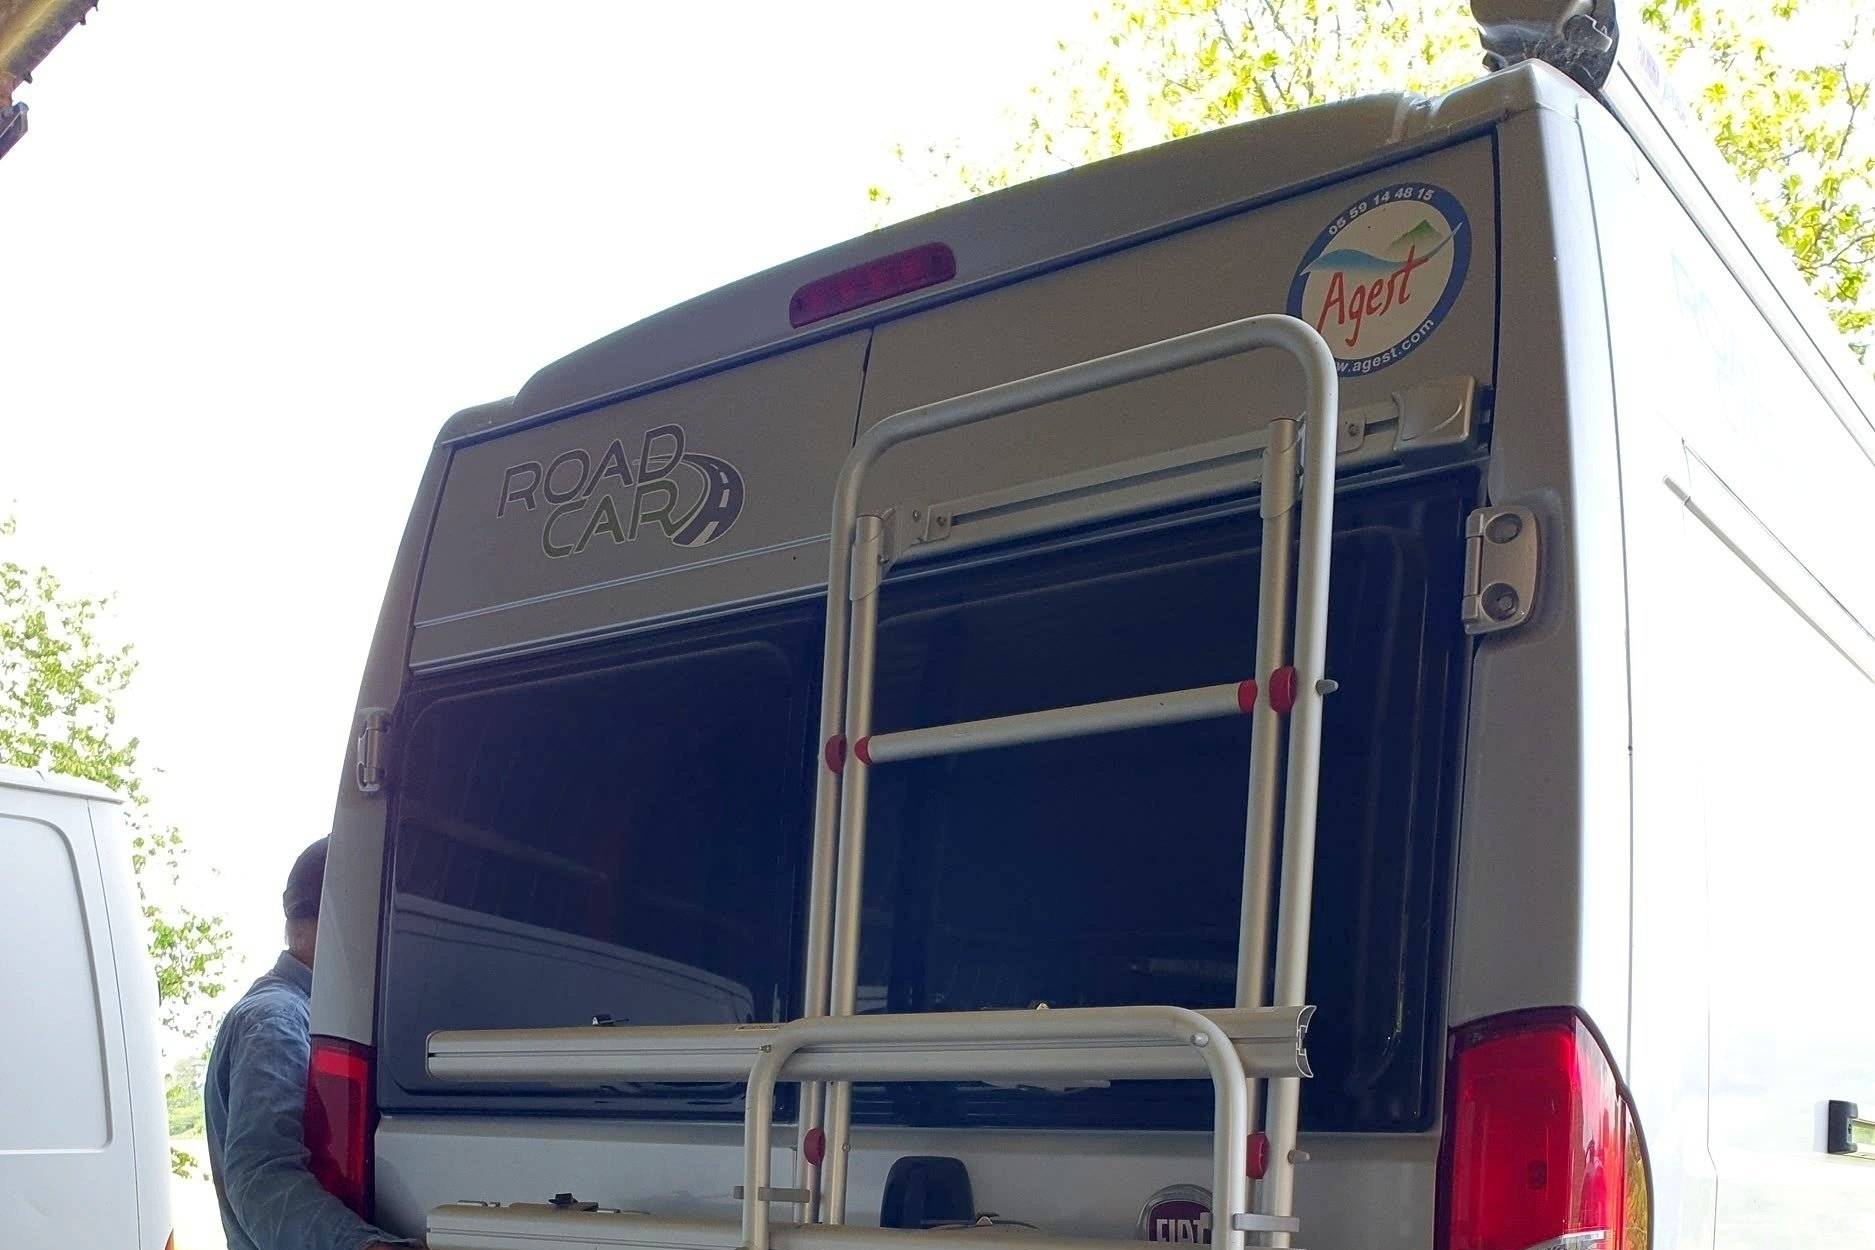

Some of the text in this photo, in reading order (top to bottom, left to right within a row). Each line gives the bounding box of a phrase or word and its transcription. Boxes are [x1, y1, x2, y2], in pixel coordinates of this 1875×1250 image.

[1328, 187, 1435, 236] 05 59 14 48 15
[1315, 244, 1430, 347] Agest
[1336, 318, 1435, 373] w.agest.com
[497, 423, 686, 519] ROAD
[542, 478, 680, 559] CAR
[1156, 1218, 1208, 1244] FIAT
